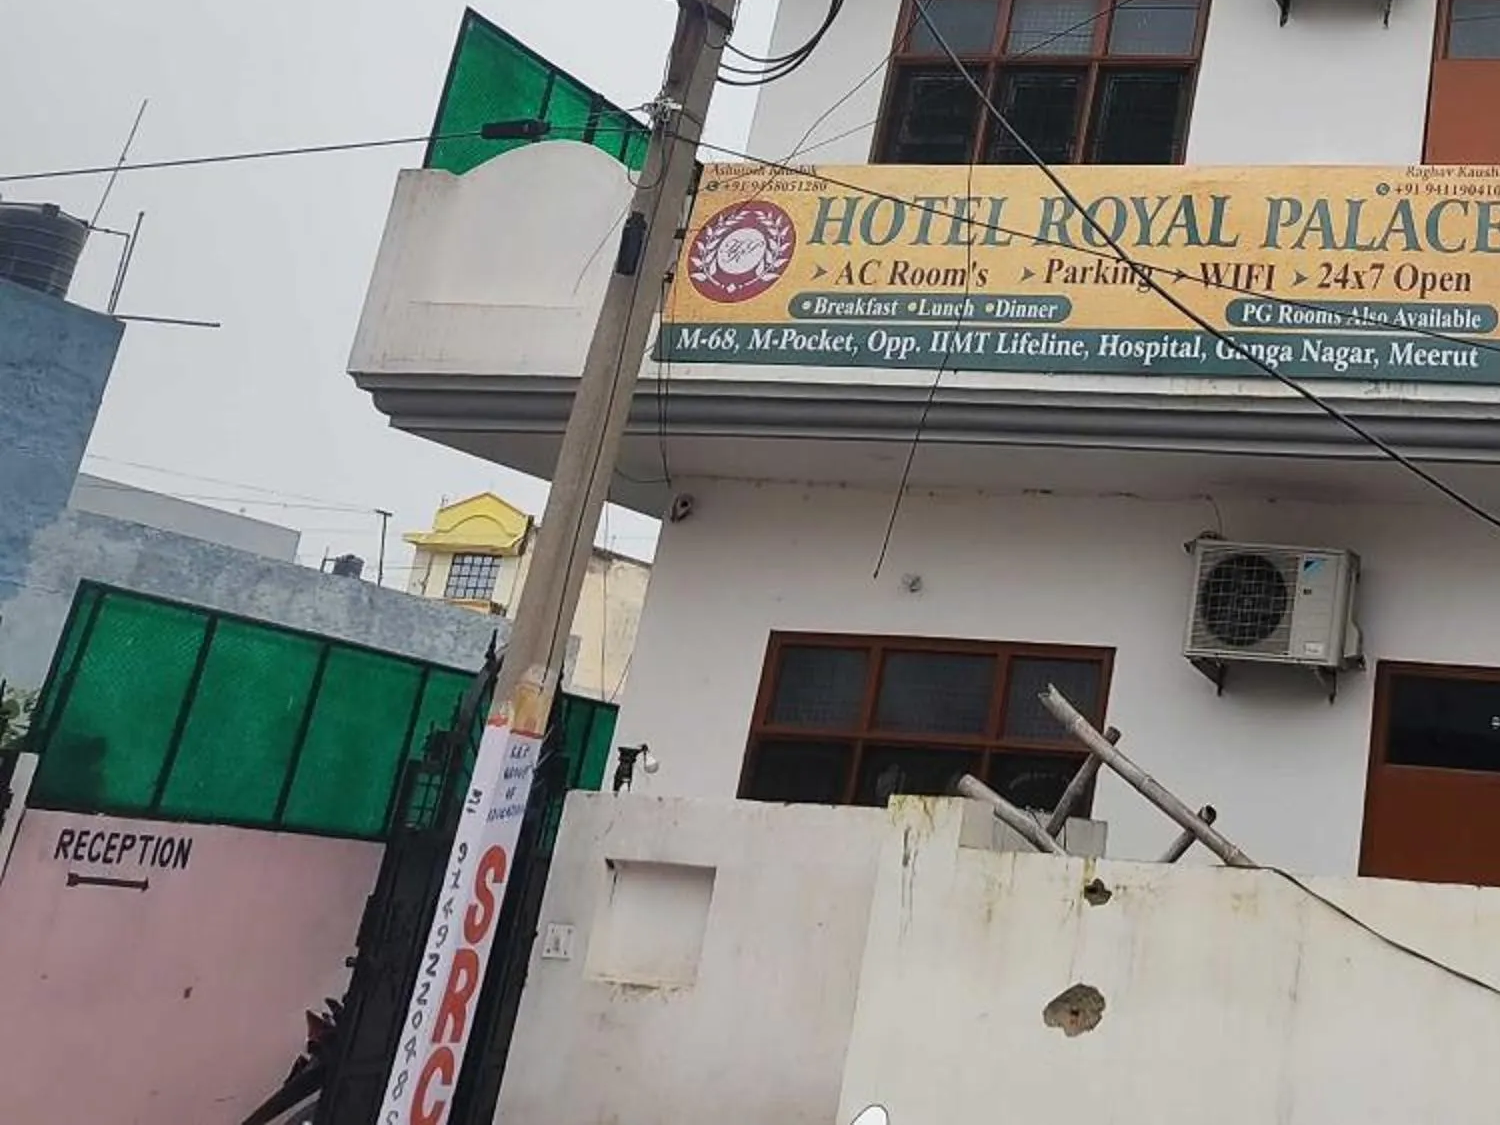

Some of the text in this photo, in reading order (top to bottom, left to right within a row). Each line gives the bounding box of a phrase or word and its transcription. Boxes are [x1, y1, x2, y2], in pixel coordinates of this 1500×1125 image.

[1395, 183, 1420, 196] +91
[806, 195, 1014, 247] HOTEL
[1033, 194, 1239, 249] ROYAL
[834, 259, 989, 287] AC Room's
[1044, 257, 1154, 293] Parking
[1200, 262, 1277, 290] WIFI
[1317, 262, 1472, 299] 24x7 Open
[813, 298, 1058, 319] Breakfast Lunch Dinner
[1242, 304, 1482, 329] PG Rooms Also Available
[676, 328, 741, 354] M-68,
[749, 328, 860, 357] M-Pocket,
[867, 331, 921, 360] Opp.
[995, 331, 1090, 359] Lifeline,
[1098, 334, 1208, 365] Hospital,
[1215, 338, 1295, 371] Ganga
[1300, 340, 1380, 372] Nagar,
[1389, 341, 1479, 367] Meerut
[53, 828, 193, 870] RECEPTION
